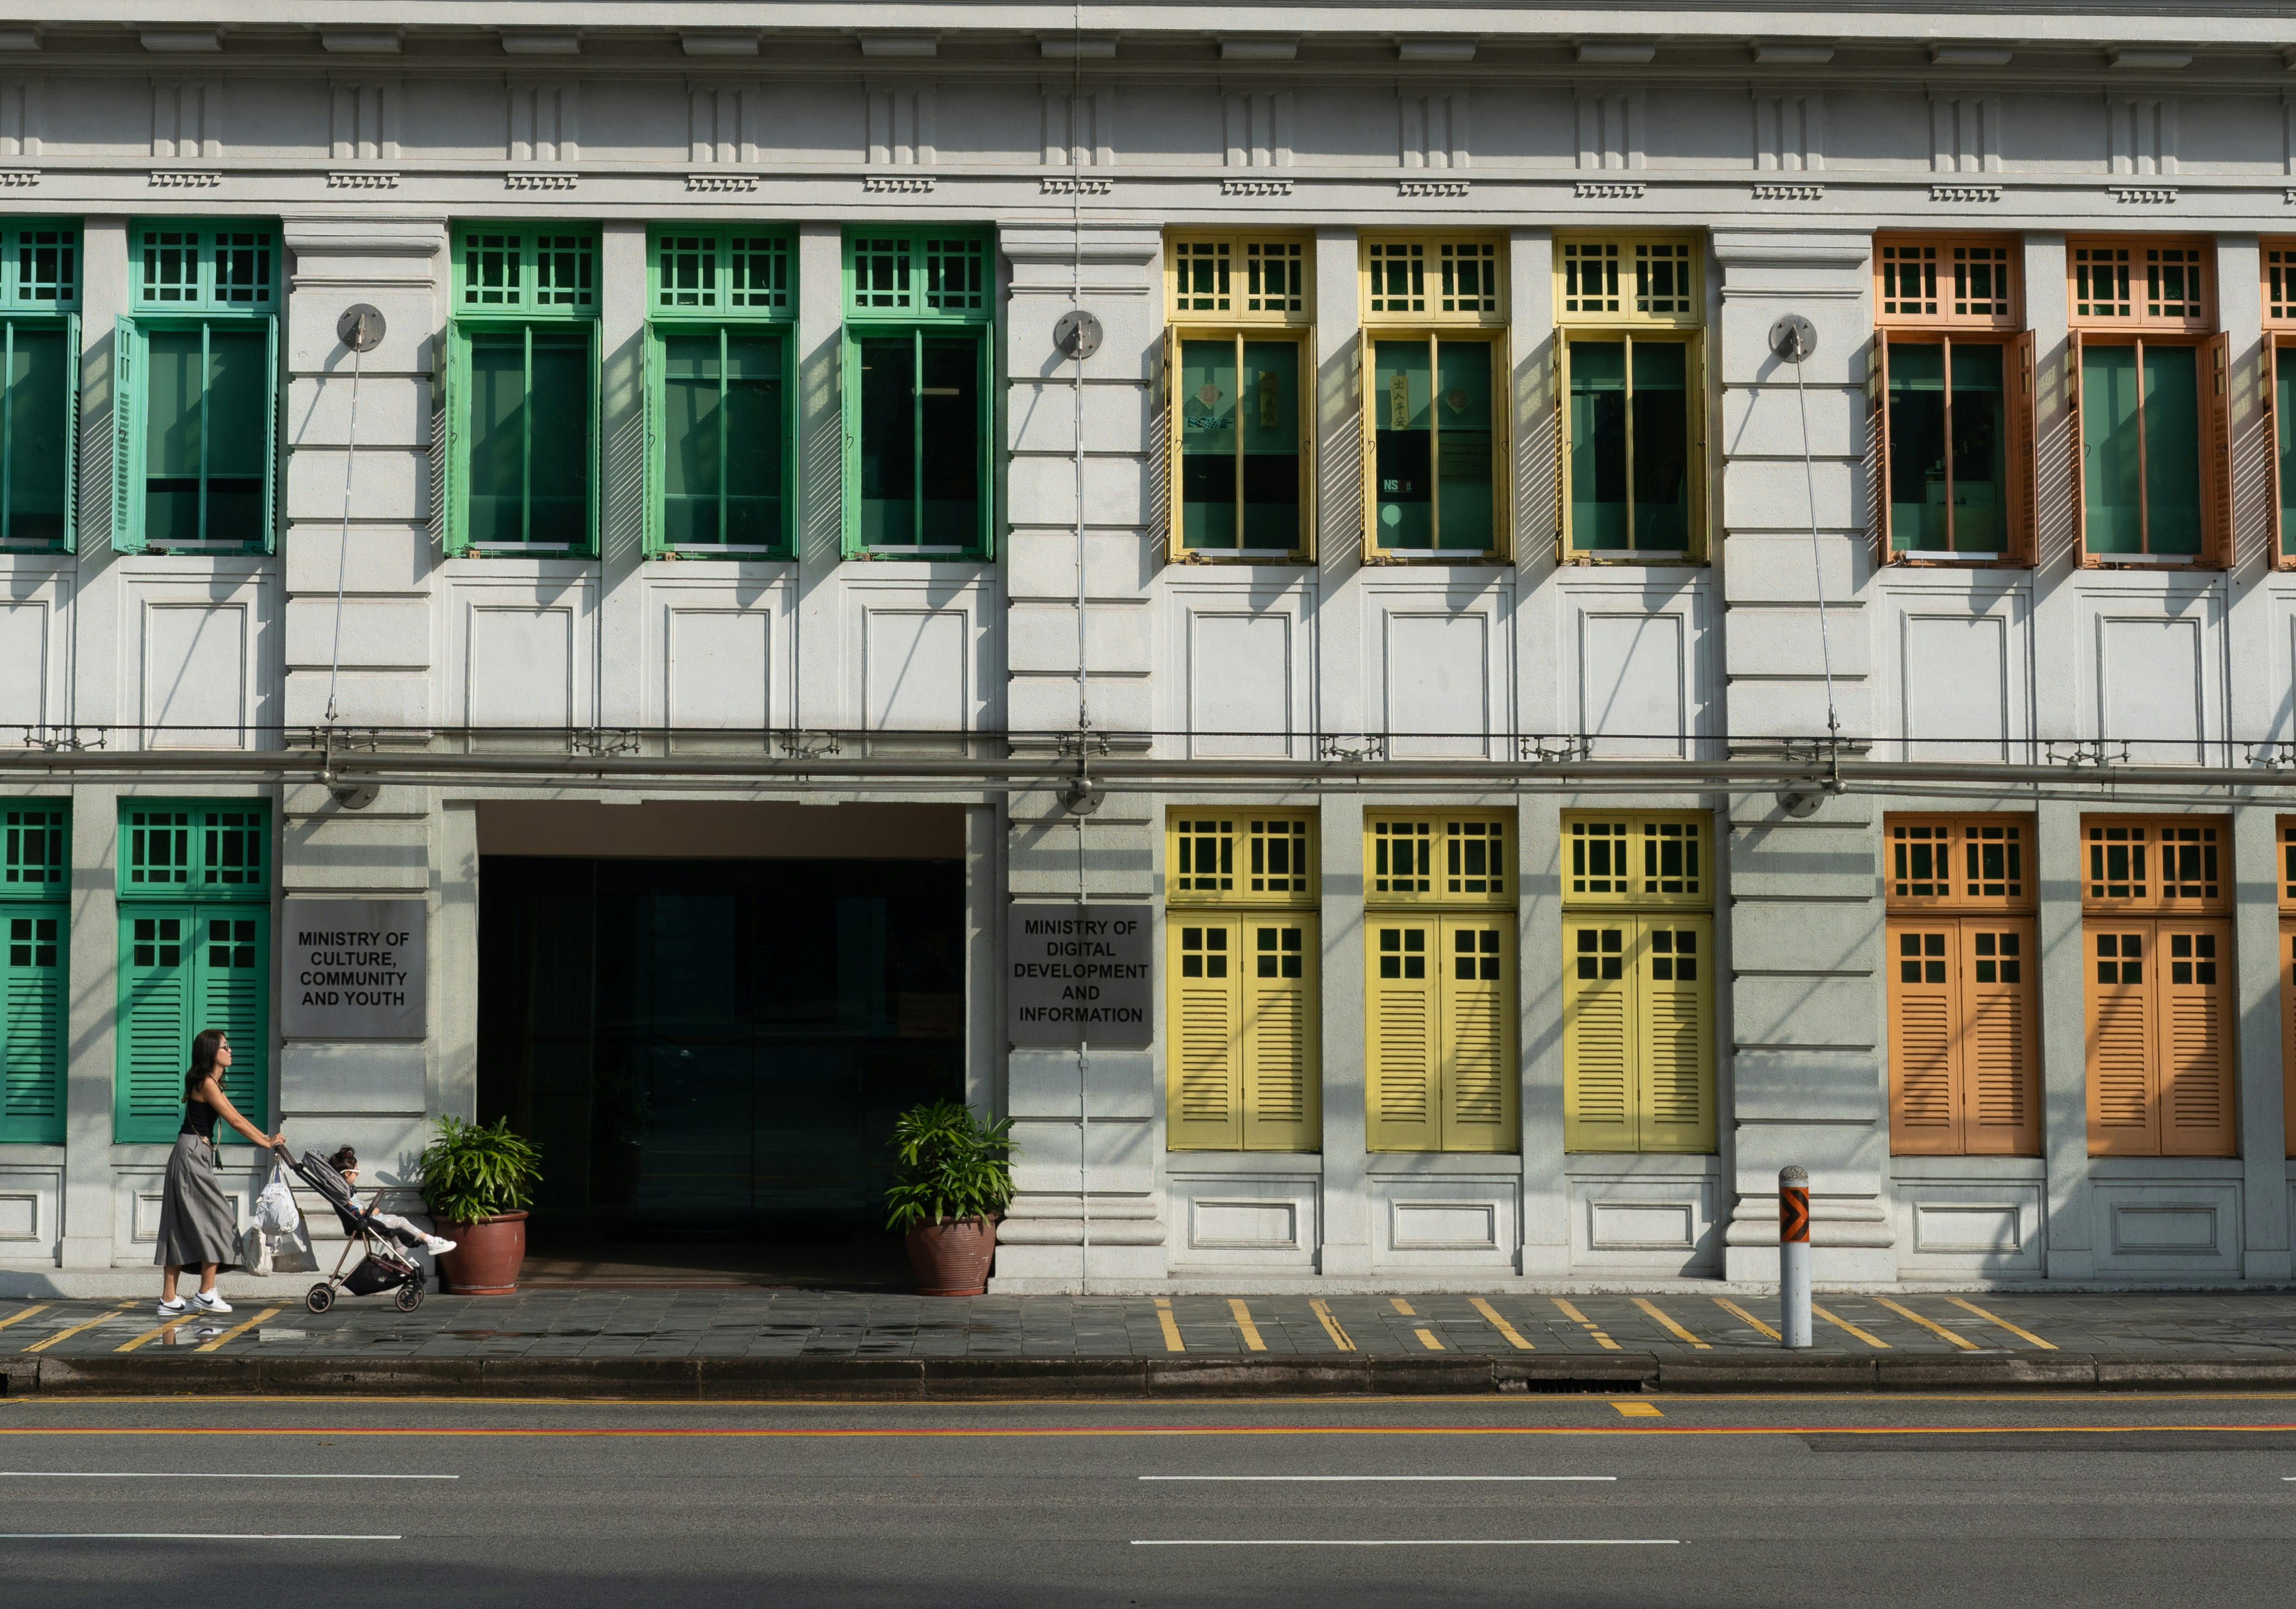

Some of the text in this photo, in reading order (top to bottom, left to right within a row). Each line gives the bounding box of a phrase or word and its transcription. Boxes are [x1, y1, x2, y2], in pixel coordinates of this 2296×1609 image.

[1393, 378, 1406, 427] 出入平安
[1025, 920, 1137, 935] MINISTRY OF
[299, 932, 410, 946] MINISTRY OF
[1047, 942, 1116, 956] DIGITAL
[310, 951, 396, 969] CULTURE,
[300, 971, 407, 986] COMMUNITY
[1014, 963, 1149, 979] DEVELOPMENT
[301, 991, 405, 1006] AND YOUTH
[1062, 985, 1100, 1000] AND
[1020, 1007, 1142, 1022] INFORMATION
